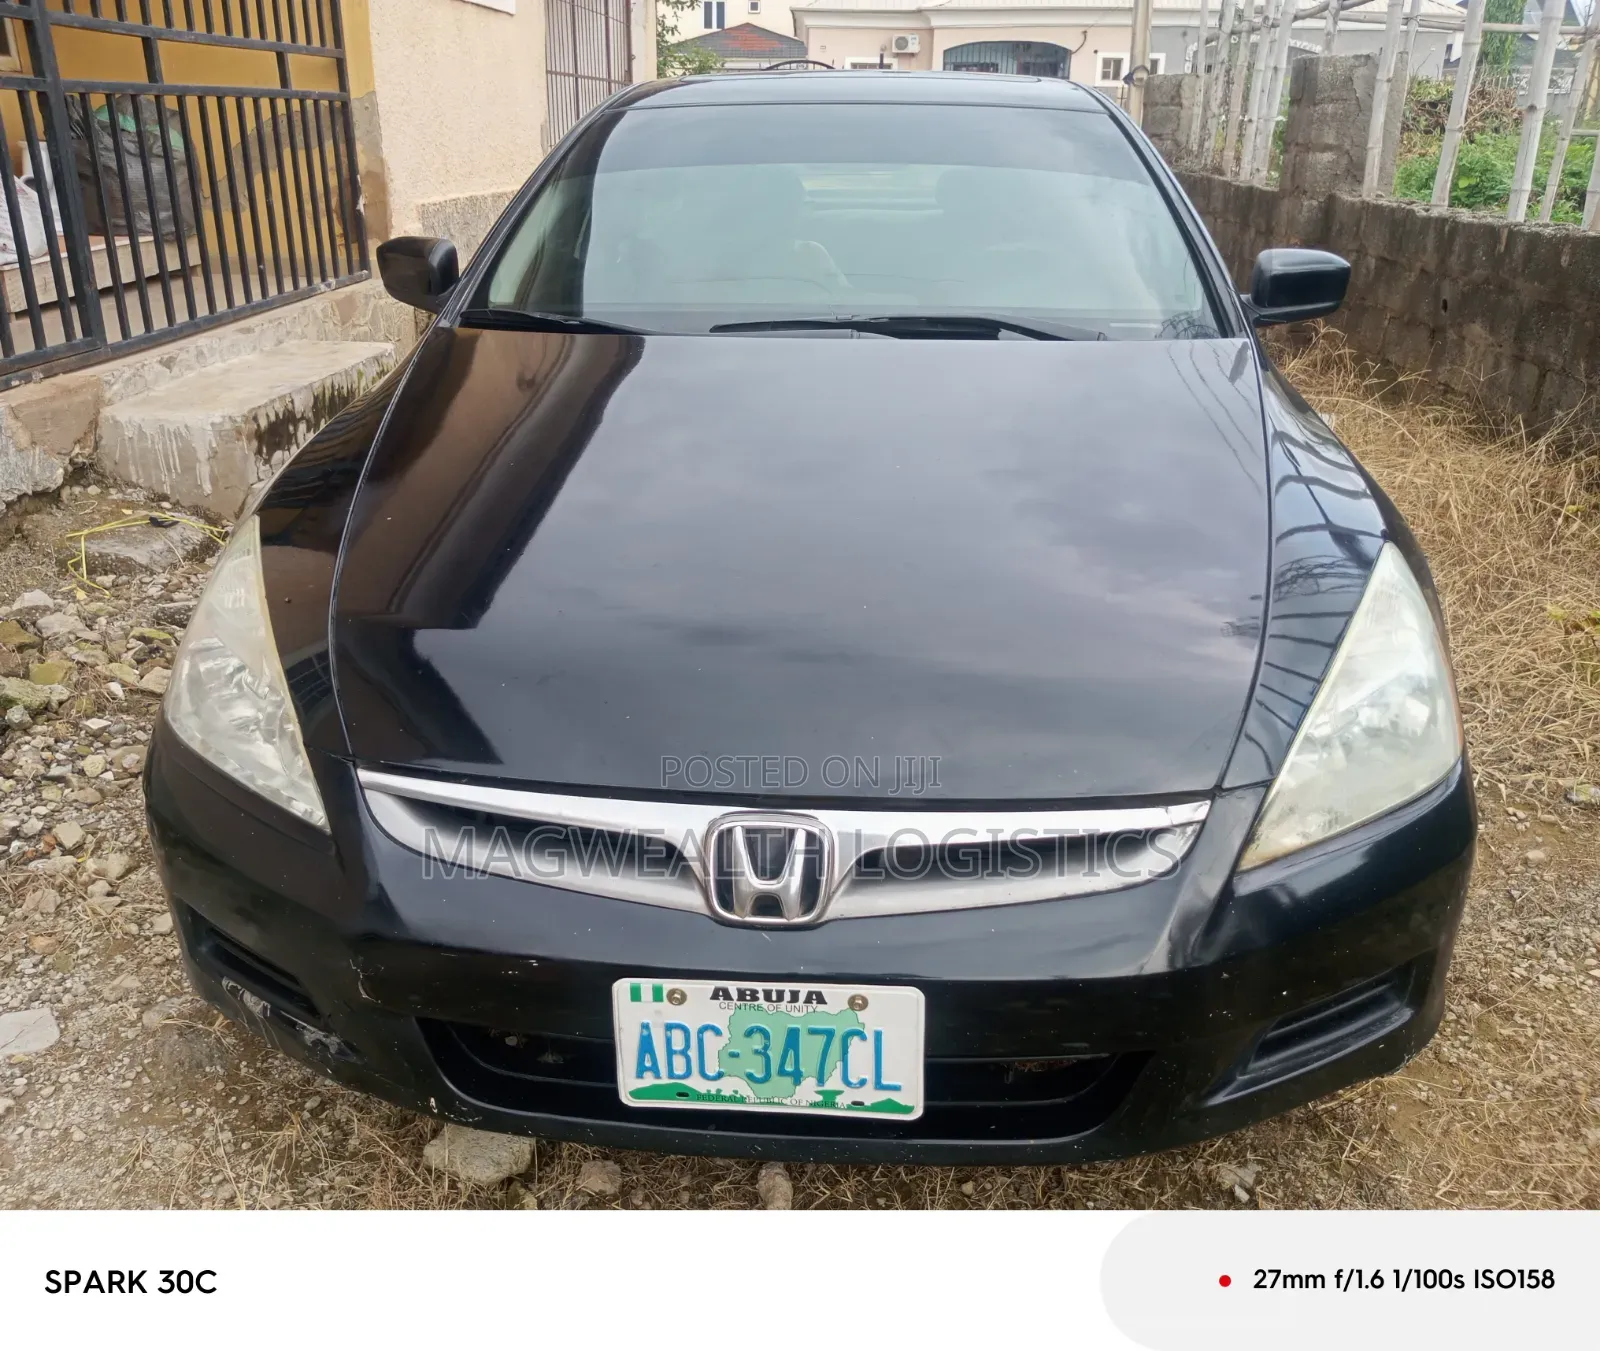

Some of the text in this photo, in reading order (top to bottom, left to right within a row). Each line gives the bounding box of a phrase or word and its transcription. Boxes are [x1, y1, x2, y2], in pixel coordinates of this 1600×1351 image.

[709, 985, 828, 1005] ABUJA
[719, 1001, 818, 1014] CENTRE OF UNITY
[635, 1020, 903, 1092] ABC-347CL
